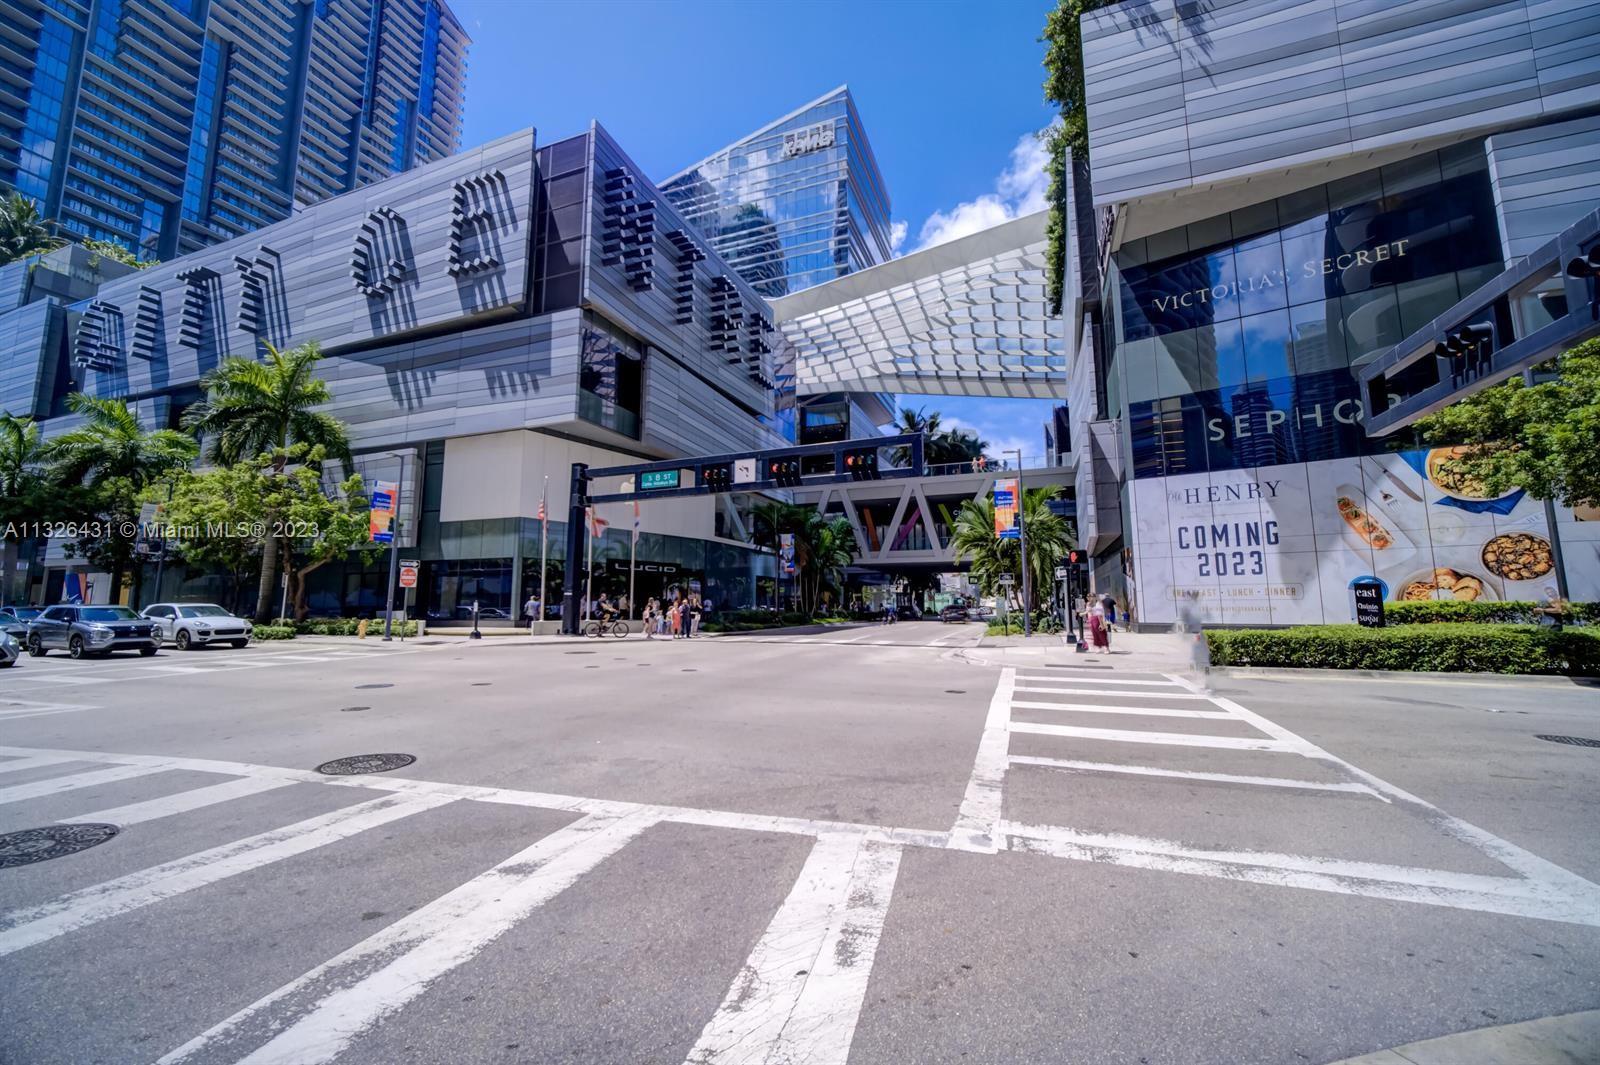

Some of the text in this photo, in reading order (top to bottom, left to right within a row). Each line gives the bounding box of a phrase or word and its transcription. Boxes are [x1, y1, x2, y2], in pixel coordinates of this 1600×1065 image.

[782, 128, 834, 159] KPMG
[1152, 239, 1410, 313] VICTORIA'S SECRET
[1184, 480, 1282, 504] HENRY
[1178, 520, 1280, 550] COMING
[614, 563, 677, 573] LUCID
[1198, 550, 1264, 577] 2023
[1227, 587, 1254, 597] LUNCH
[1264, 587, 1297, 597] DINNER
[1356, 589, 1377, 598] east
[1358, 614, 1379, 625] sugar
